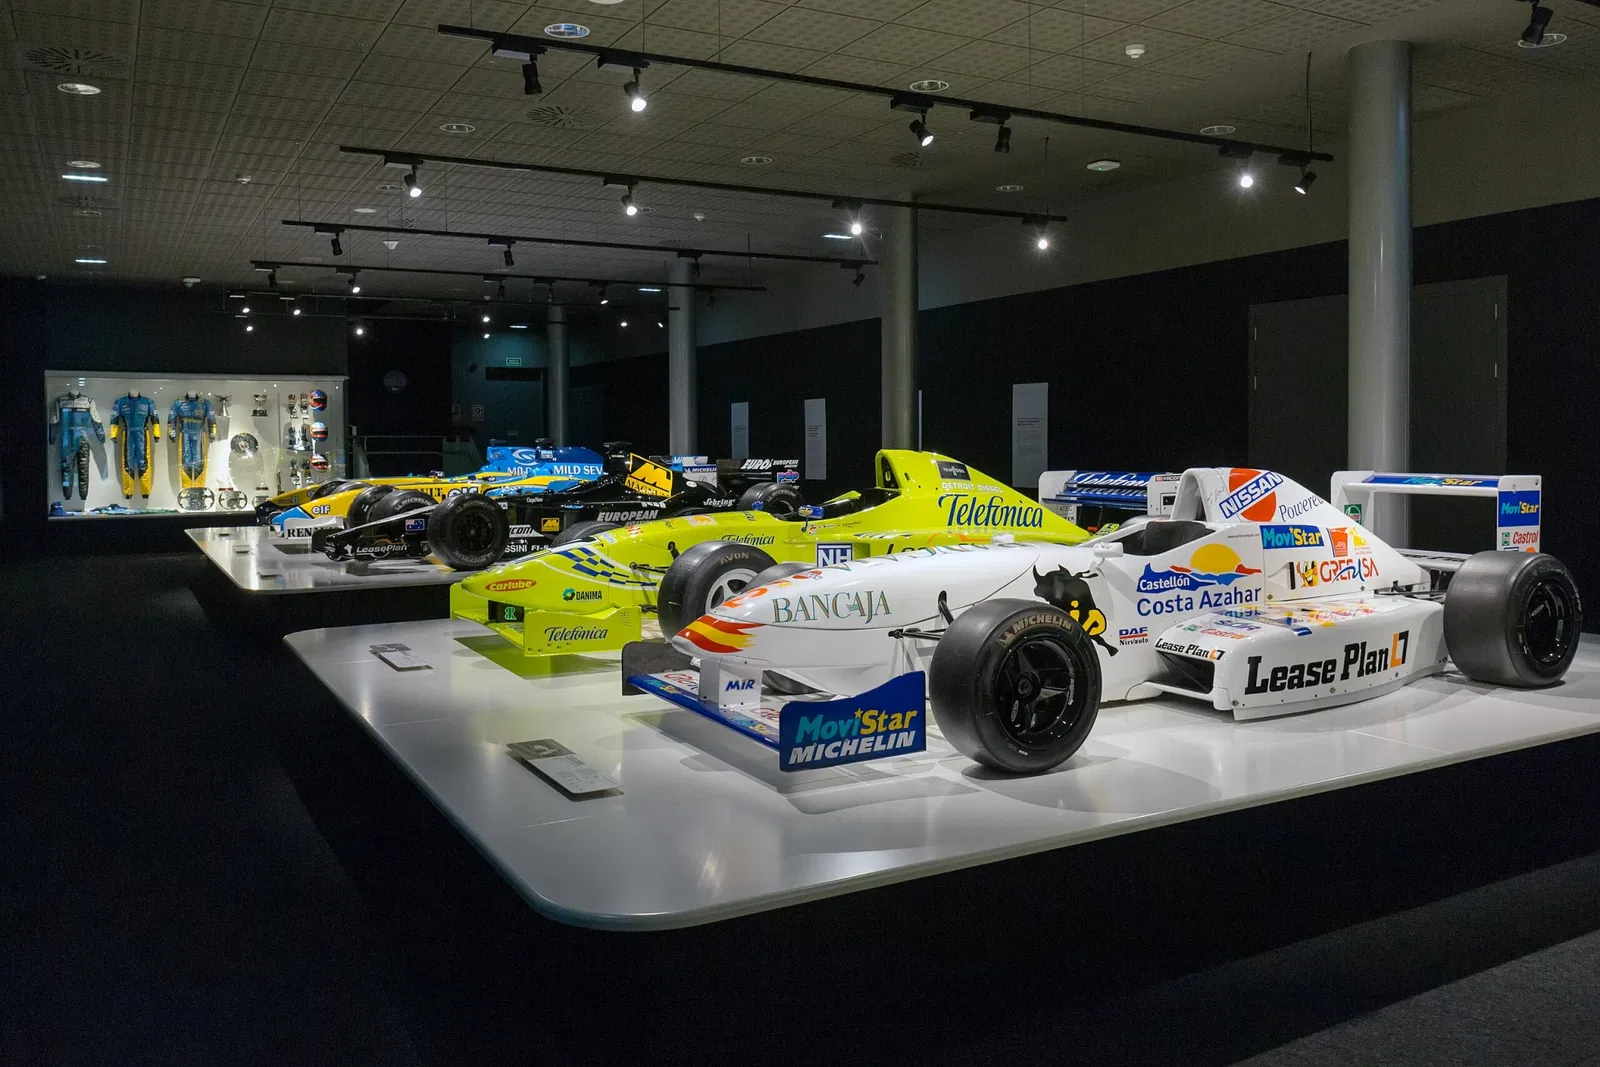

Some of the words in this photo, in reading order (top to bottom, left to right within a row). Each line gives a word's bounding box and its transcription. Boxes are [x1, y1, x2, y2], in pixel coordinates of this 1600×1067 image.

[553, 464, 580, 475] MILD
[942, 482, 974, 491] DETROIT
[977, 484, 1003, 493] DIESEL
[1220, 472, 1283, 518] NISSAN
[312, 505, 331, 515] elf
[597, 510, 659, 522] EUROPEAN
[1501, 501, 1540, 515] MoviStar
[1262, 526, 1321, 547] MoviStar
[1512, 530, 1540, 545] Castrol
[720, 552, 749, 565] AVON
[1139, 575, 1190, 591] Castellón
[576, 590, 603, 601] DANIMA
[1136, 594, 1194, 616] Costa
[1199, 587, 1261, 609] Azahar
[772, 590, 892, 625] BANCAJA
[1012, 614, 1073, 634] MICHELIN
[1119, 626, 1148, 636] DAF
[1154, 638, 1186, 653] Lease
[1185, 643, 1209, 658] Plan
[1244, 655, 1337, 695] Lease
[1340, 641, 1389, 681] Plan
[795, 707, 918, 744] MoviStar
[789, 730, 917, 765] MICHELIN
